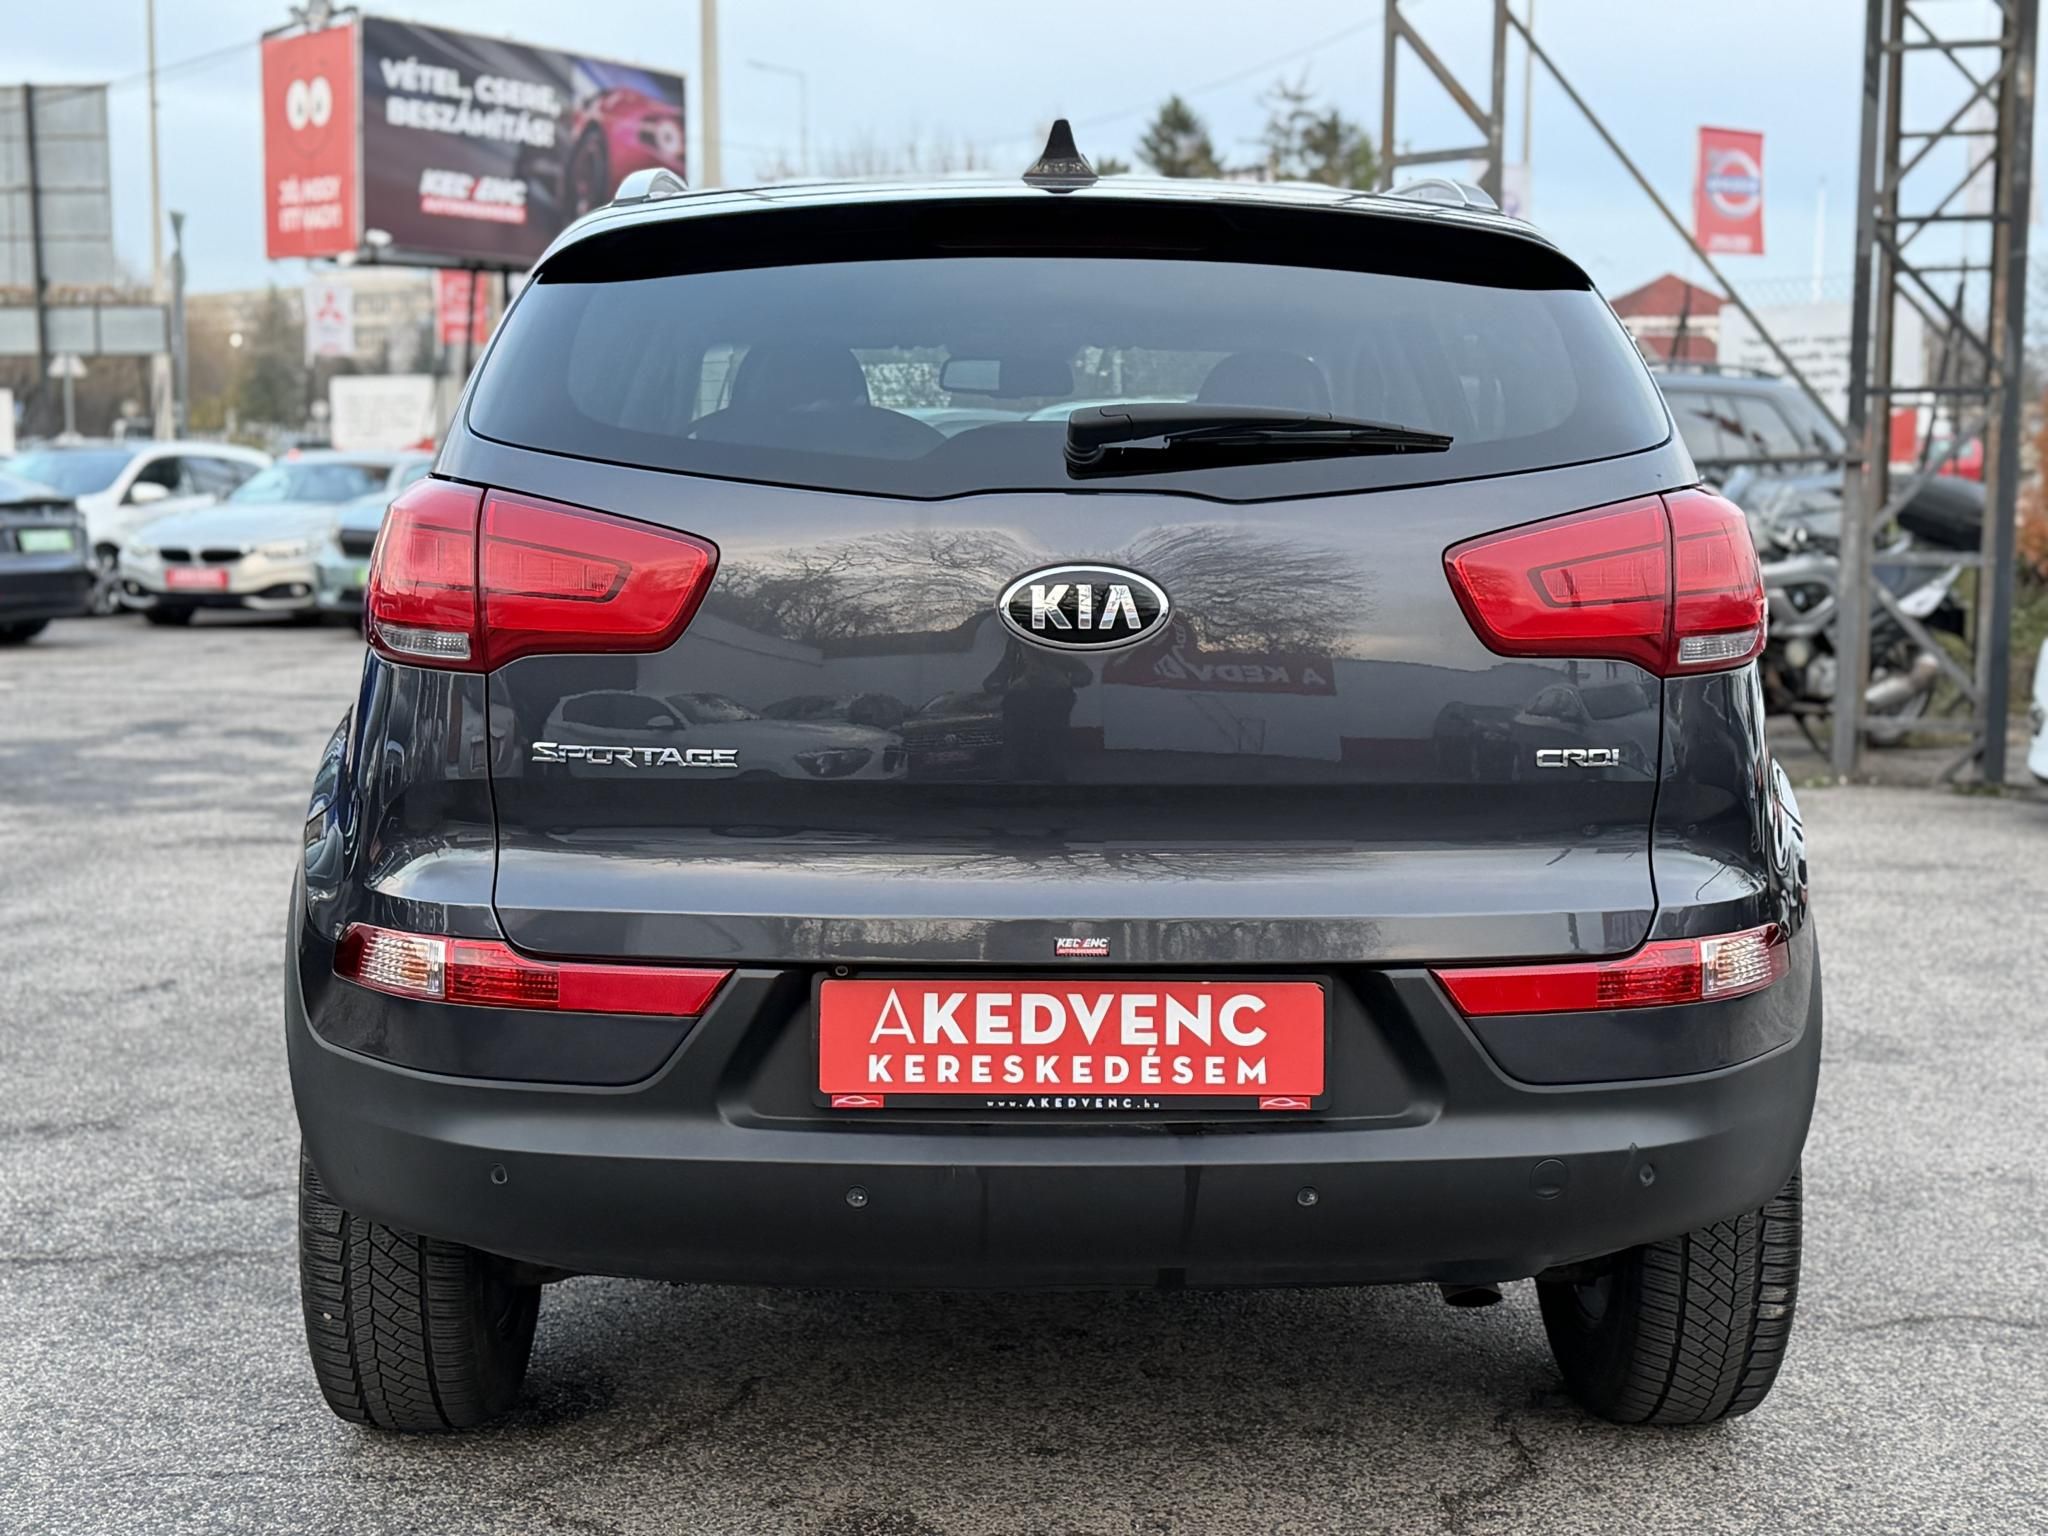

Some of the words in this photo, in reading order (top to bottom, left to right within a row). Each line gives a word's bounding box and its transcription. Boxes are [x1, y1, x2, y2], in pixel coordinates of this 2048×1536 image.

[1029, 584, 1141, 630] KIA
[532, 742, 738, 768] SPORTAGE
[1537, 749, 1619, 767] CRDI
[869, 1048, 1268, 1084] KERESKEDÉSEM
[987, 1098, 1160, 1109] www.AKEDVENC.hu
